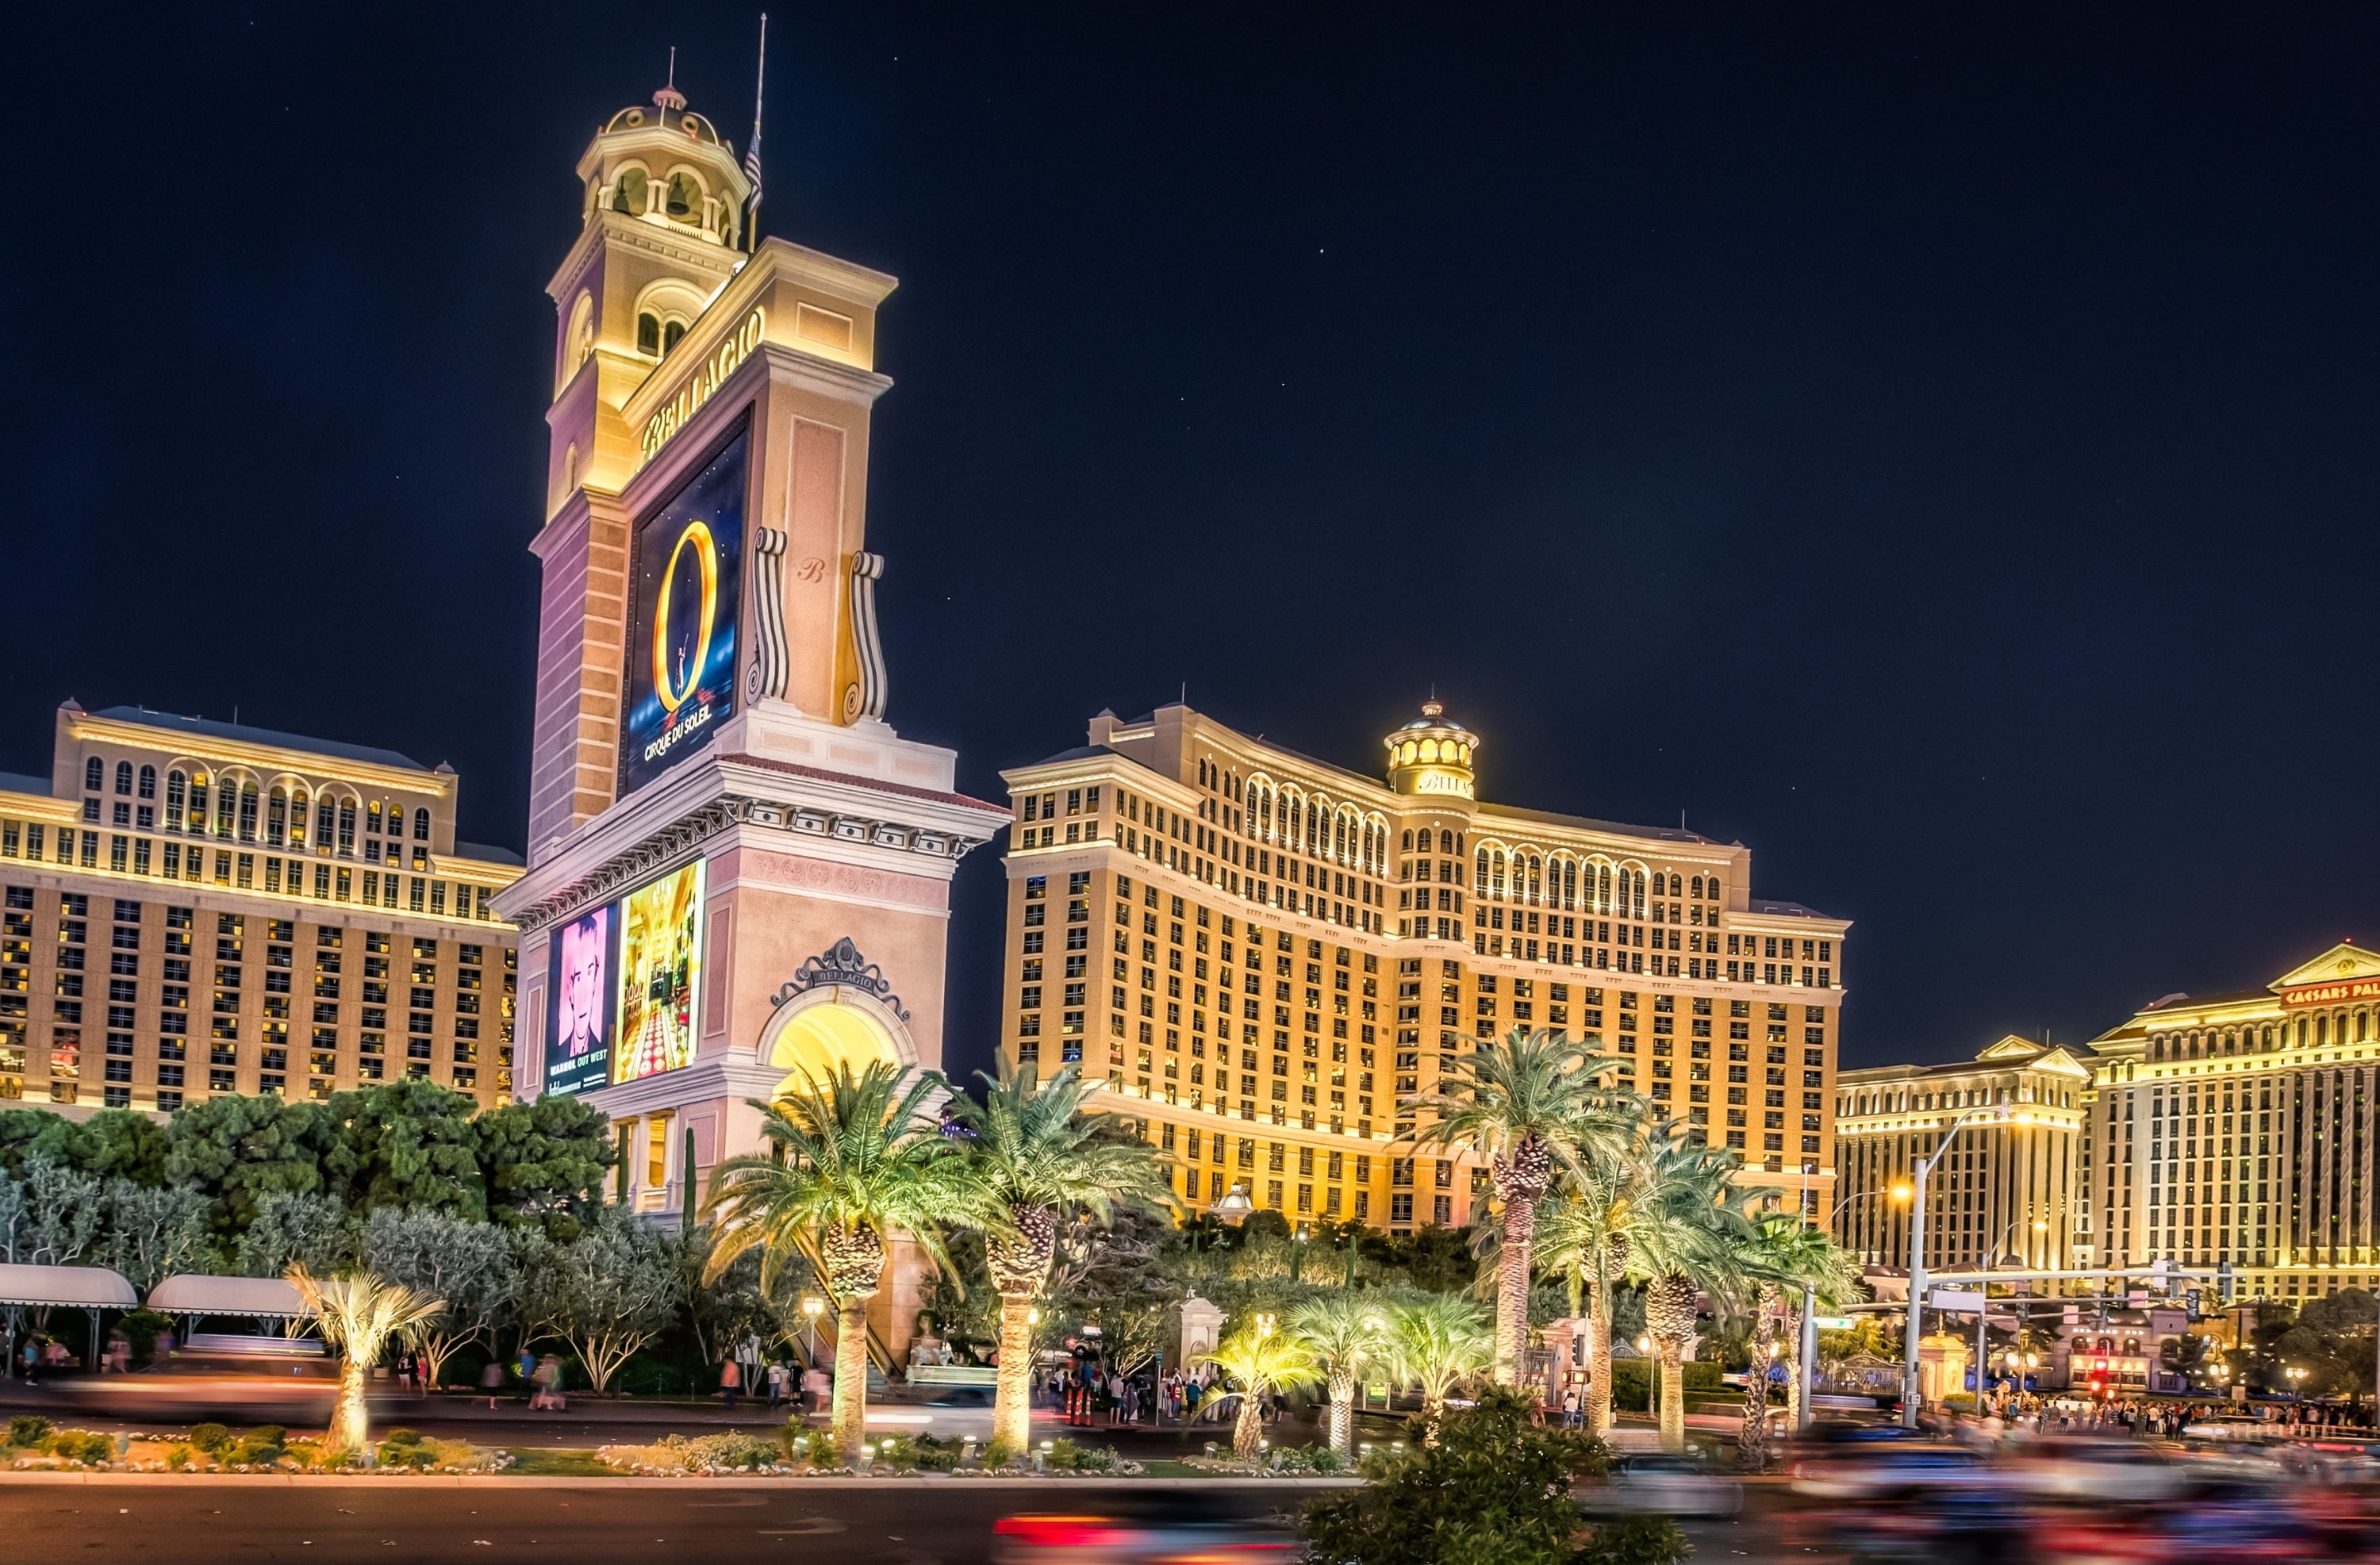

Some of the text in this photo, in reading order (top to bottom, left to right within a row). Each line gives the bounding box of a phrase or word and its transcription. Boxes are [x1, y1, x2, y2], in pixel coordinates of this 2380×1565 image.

[635, 305, 766, 472] BELLAGIO
[797, 557, 826, 583] B
[652, 521, 717, 712] O
[644, 704, 712, 761] CIRQUE DU SOLEIL
[819, 971, 872, 988] BELLAGIO
[2286, 986, 2348, 1003] CAESARS
[577, 1054, 589, 1068] OUT
[590, 1049, 608, 1063] WEST
